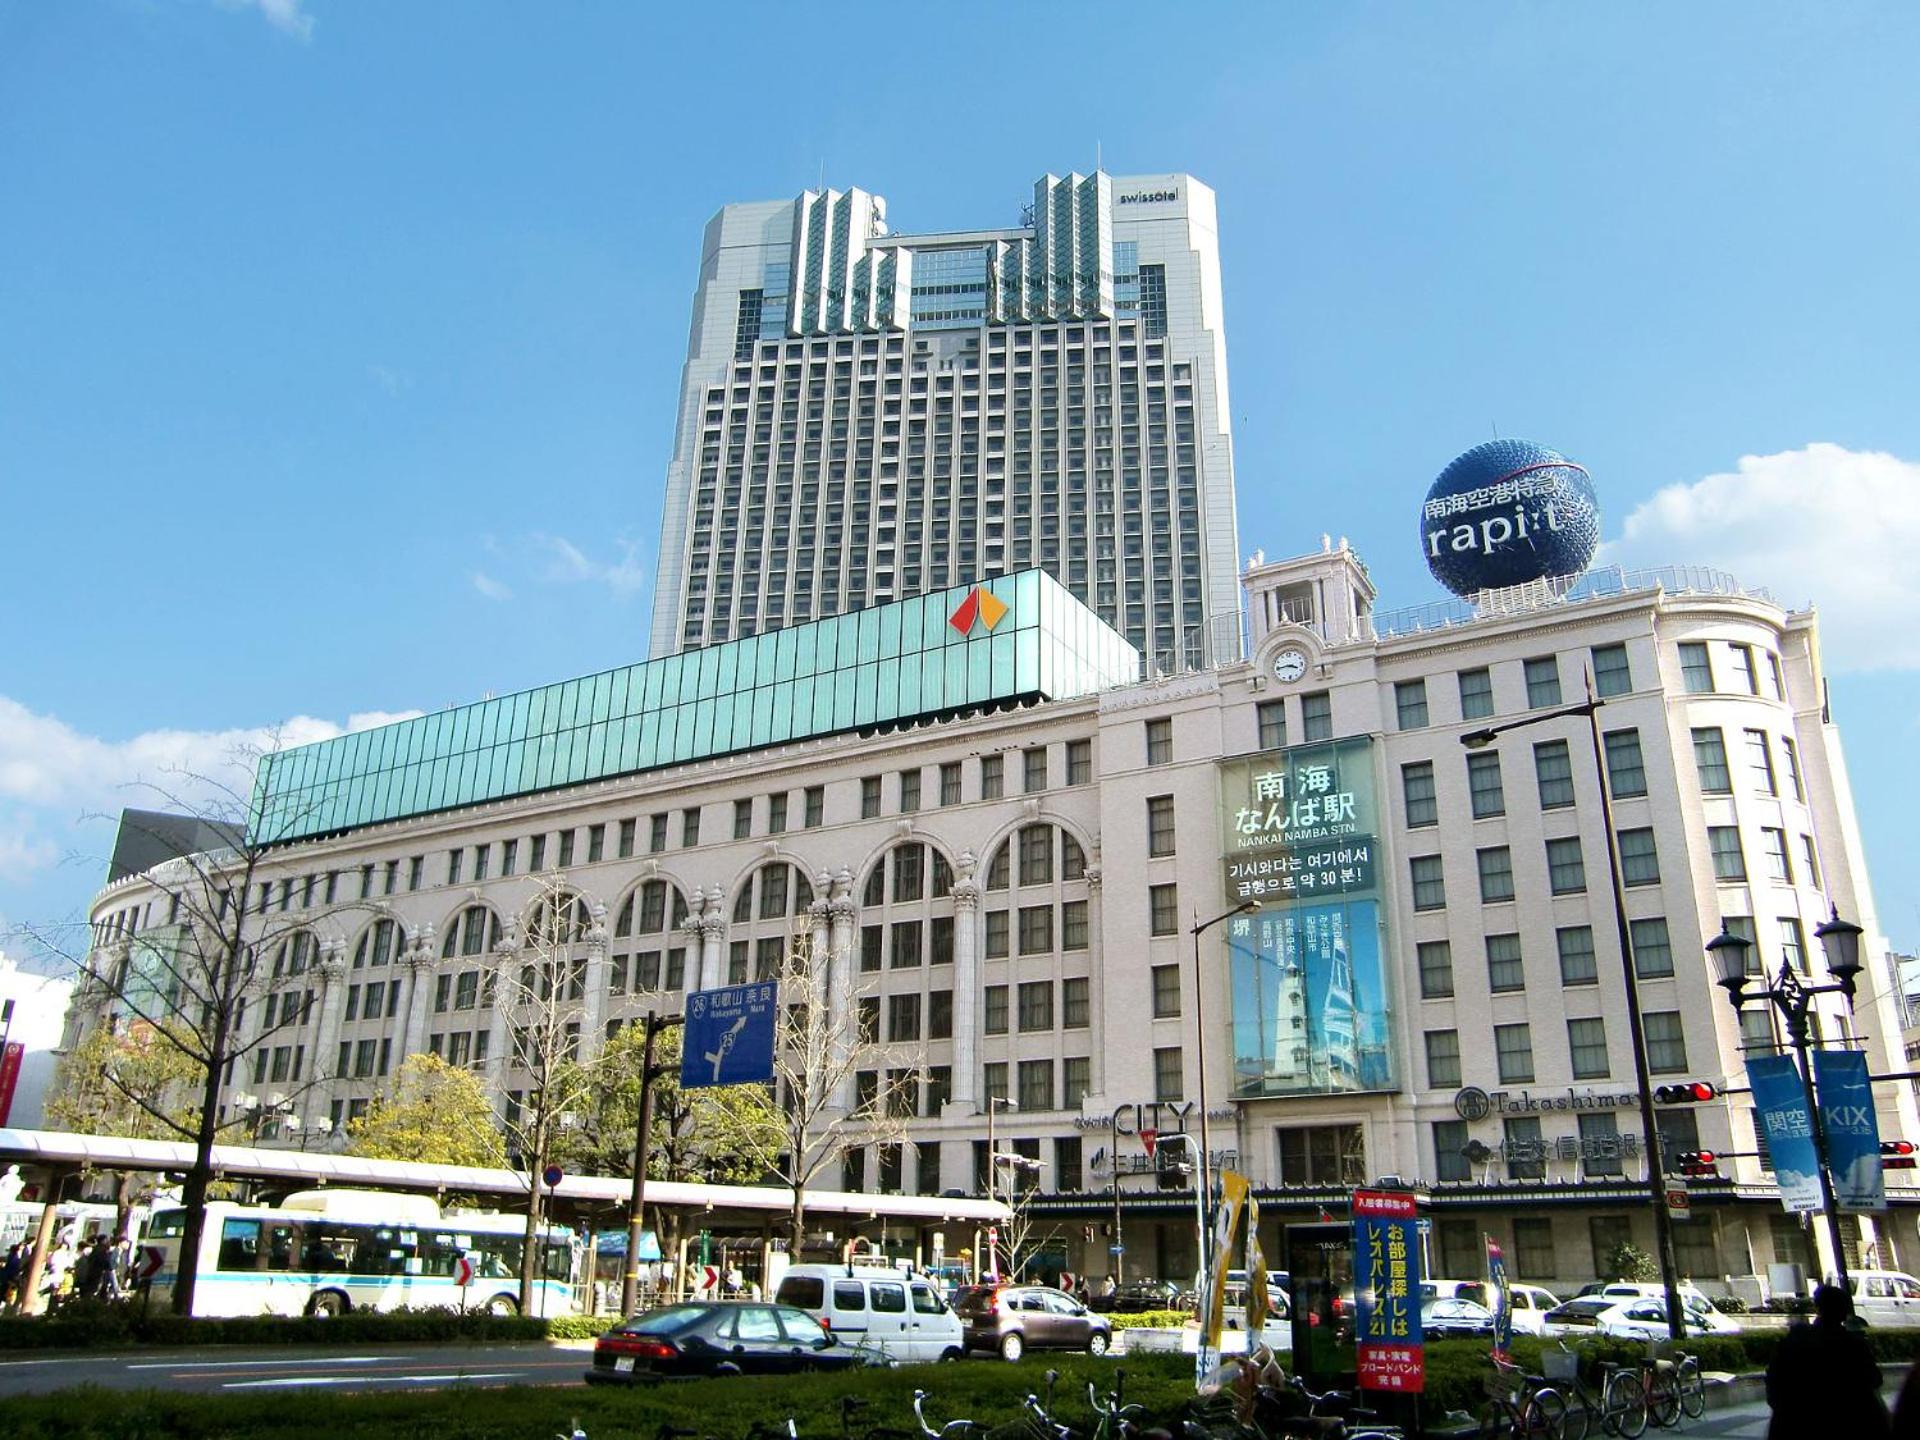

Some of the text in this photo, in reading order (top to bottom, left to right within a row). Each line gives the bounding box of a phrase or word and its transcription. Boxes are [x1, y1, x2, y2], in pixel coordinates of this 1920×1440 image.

[1425, 475, 1554, 520] 南海空港特急
[1235, 792, 1356, 834] なんば駅
[1238, 833, 1281, 848] NANKAI
[1284, 827, 1328, 841] NAMBA
[1229, 847, 1369, 878] 기시와다는 여기에서
[1237, 876, 1296, 897] 급행으로
[1300, 873, 1315, 888] 약
[1320, 871, 1336, 885] 30
[1233, 918, 1250, 937] 堺
[1491, 1087, 1665, 1113] Takashimaa
[1114, 1101, 1194, 1136] CITY
[1764, 1109, 1809, 1132] 関空
[1825, 1106, 1871, 1126] KIX
[1368, 1222, 1386, 1336] レオパレス21
[1388, 1223, 1408, 1336] お部屋探しは
